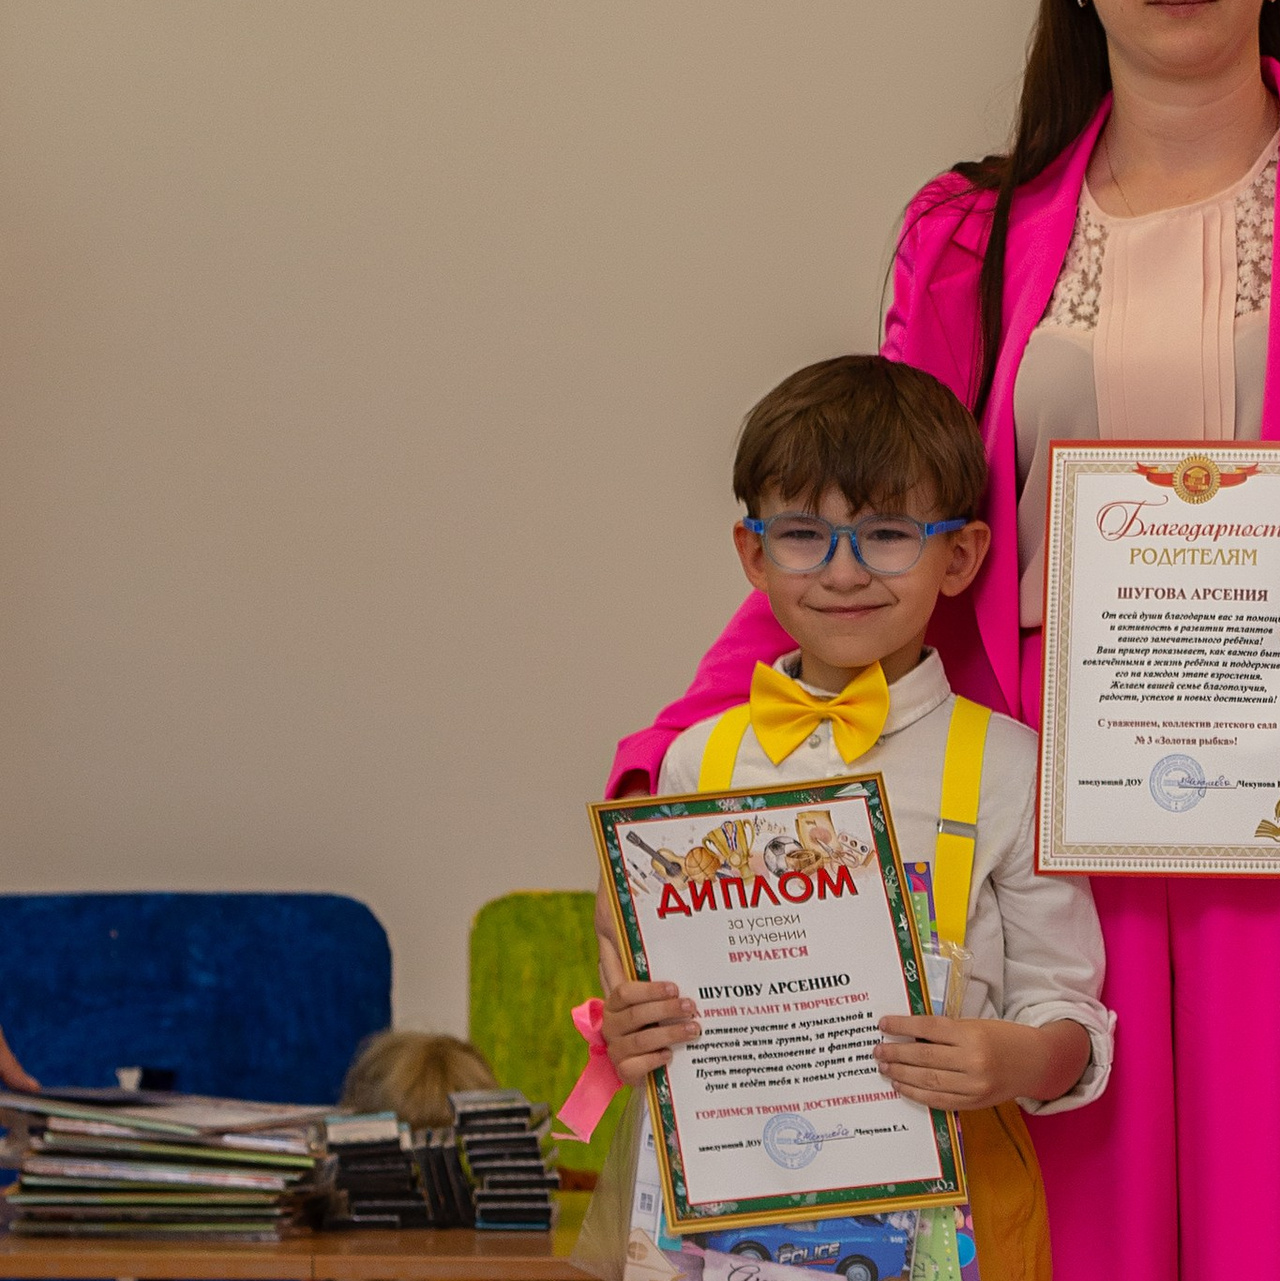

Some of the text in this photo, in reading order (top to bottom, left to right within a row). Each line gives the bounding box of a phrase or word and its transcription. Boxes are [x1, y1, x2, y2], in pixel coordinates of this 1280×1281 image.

[1129, 547, 1258, 567] РОДИТЕЛЯМ
[1117, 587, 1269, 602] ШУГОВА АРСЕНИЯ
[1101, 610, 1117, 620] От
[1118, 612, 1138, 620] всей
[1139, 612, 1163, 622] души
[1164, 612, 1216, 623] благодарим
[1117, 624, 1172, 632] активность
[1179, 625, 1224, 634] развитии
[1226, 626, 1273, 634] талантов
[1150, 636, 1222, 644] замечательного
[1223, 636, 1264, 646] ребёнка!
[1096, 645, 1116, 655] Ваш
[1118, 647, 1151, 657] пример
[1152, 648, 1208, 656] показывает,
[1227, 649, 1258, 657] важно
[1082, 658, 1145, 666] вовлечёнными
[1183, 658, 1220, 669] ребёнка
[1143, 669, 1179, 678] каждом
[1181, 671, 1209, 679] этапе
[1210, 672, 1263, 681] взросления.
[1109, 681, 1145, 689] Желаем
[1146, 682, 1175, 690] вашей
[1203, 682, 1268, 693] благополучия,
[1098, 693, 1139, 703] радости,
[1140, 694, 1175, 703] успехов
[1184, 694, 1211, 702] новых
[1213, 694, 1278, 704] достижений!
[1097, 718, 1106, 728] С
[1107, 720, 1161, 729] уважением,
[1162, 720, 1211, 729] коллектив
[1213, 721, 1255, 729] детского
[1134, 735, 1238, 747] № 3 «Золотая рыбка»!
[1124, 779, 1143, 787] ДОУ
[656, 865, 859, 919] ДИПЛОМ
[727, 913, 802, 931] за успехи
[728, 928, 807, 947] в изучении
[728, 945, 809, 963] ВРУЧАЕТСЯ
[698, 974, 851, 999] ШУГОВУ АРСЕНИЮ
[703, 1006, 738, 1018] ЯРКИЙ
[740, 1005, 780, 1016] ТАЛАНТ
[783, 1004, 792, 1013] И
[794, 992, 870, 1012] ТВОРЧЕСТВО!
[705, 1026, 749, 1036] активное
[750, 1023, 789, 1035] участие
[798, 1011, 864, 1030] музыкальной
[686, 1024, 880, 1052] творческой жизни группы, за прекрасны
[691, 1054, 757, 1065] выступления,
[758, 1048, 816, 1060] вдохновение
[827, 1035, 884, 1054] фантазию!
[696, 1068, 727, 1080] Пусть
[728, 1065, 784, 1077] творчества
[786, 1063, 812, 1072] огонь
[814, 1058, 846, 1069] горит
[855, 1054, 875, 1062] тво
[705, 1082, 729, 1093] душе
[739, 1078, 766, 1089] ведёт
[768, 1077, 792, 1086] тебя
[802, 1073, 836, 1083] новым
[837, 1067, 878, 1080] успехам
[695, 1090, 901, 1120] ГОРДИМСЯ ТВОИМИ ДОСТИЖЕНИЯМИ!
[745, 1138, 762, 1149] ДОУ
[779, 1241, 841, 1265] POLICE
